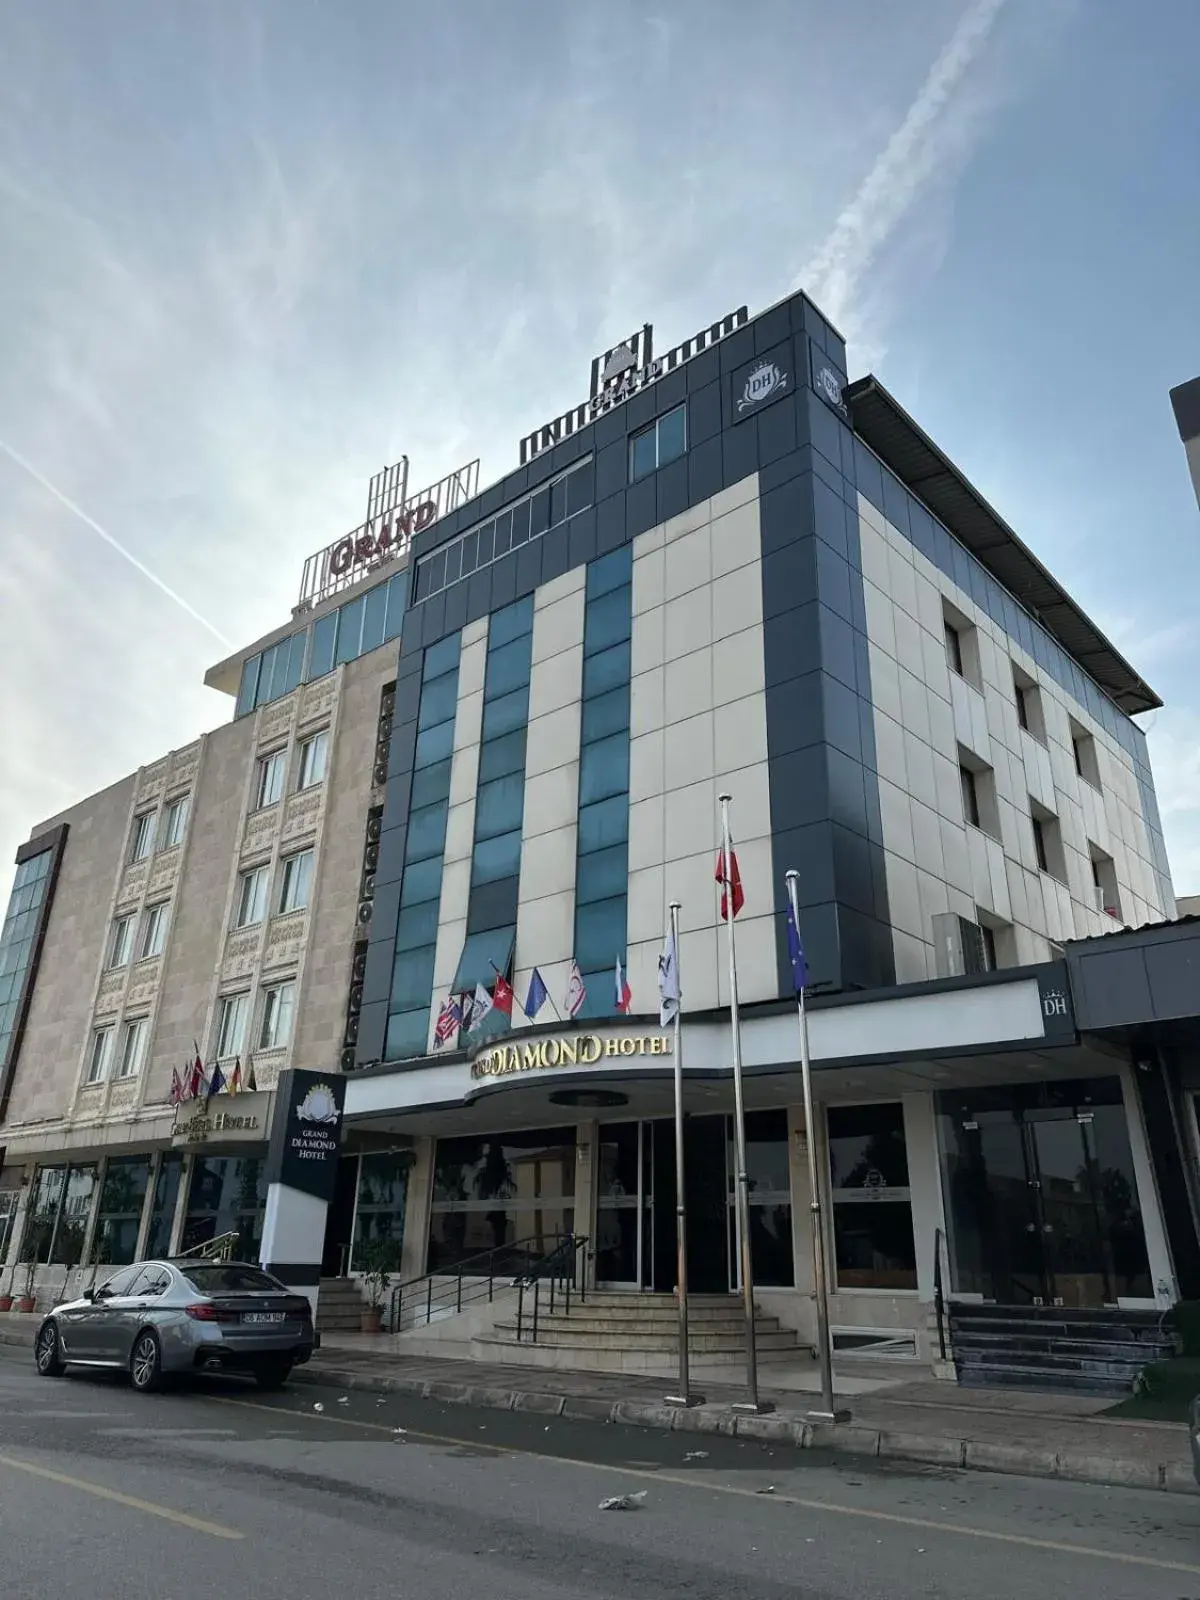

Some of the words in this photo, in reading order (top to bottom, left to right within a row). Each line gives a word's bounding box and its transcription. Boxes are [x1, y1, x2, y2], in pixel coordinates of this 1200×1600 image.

[588, 359, 664, 412] GRAND
[752, 373, 771, 393] DH
[329, 500, 436, 576] GRAND
[1044, 998, 1067, 1016] DH
[491, 1035, 602, 1075] DIAMOND
[605, 1037, 673, 1057] HOTEL
[302, 1130, 328, 1139] GRAND
[291, 1138, 336, 1151] DIAMOND
[299, 1149, 326, 1161] HOTEL
